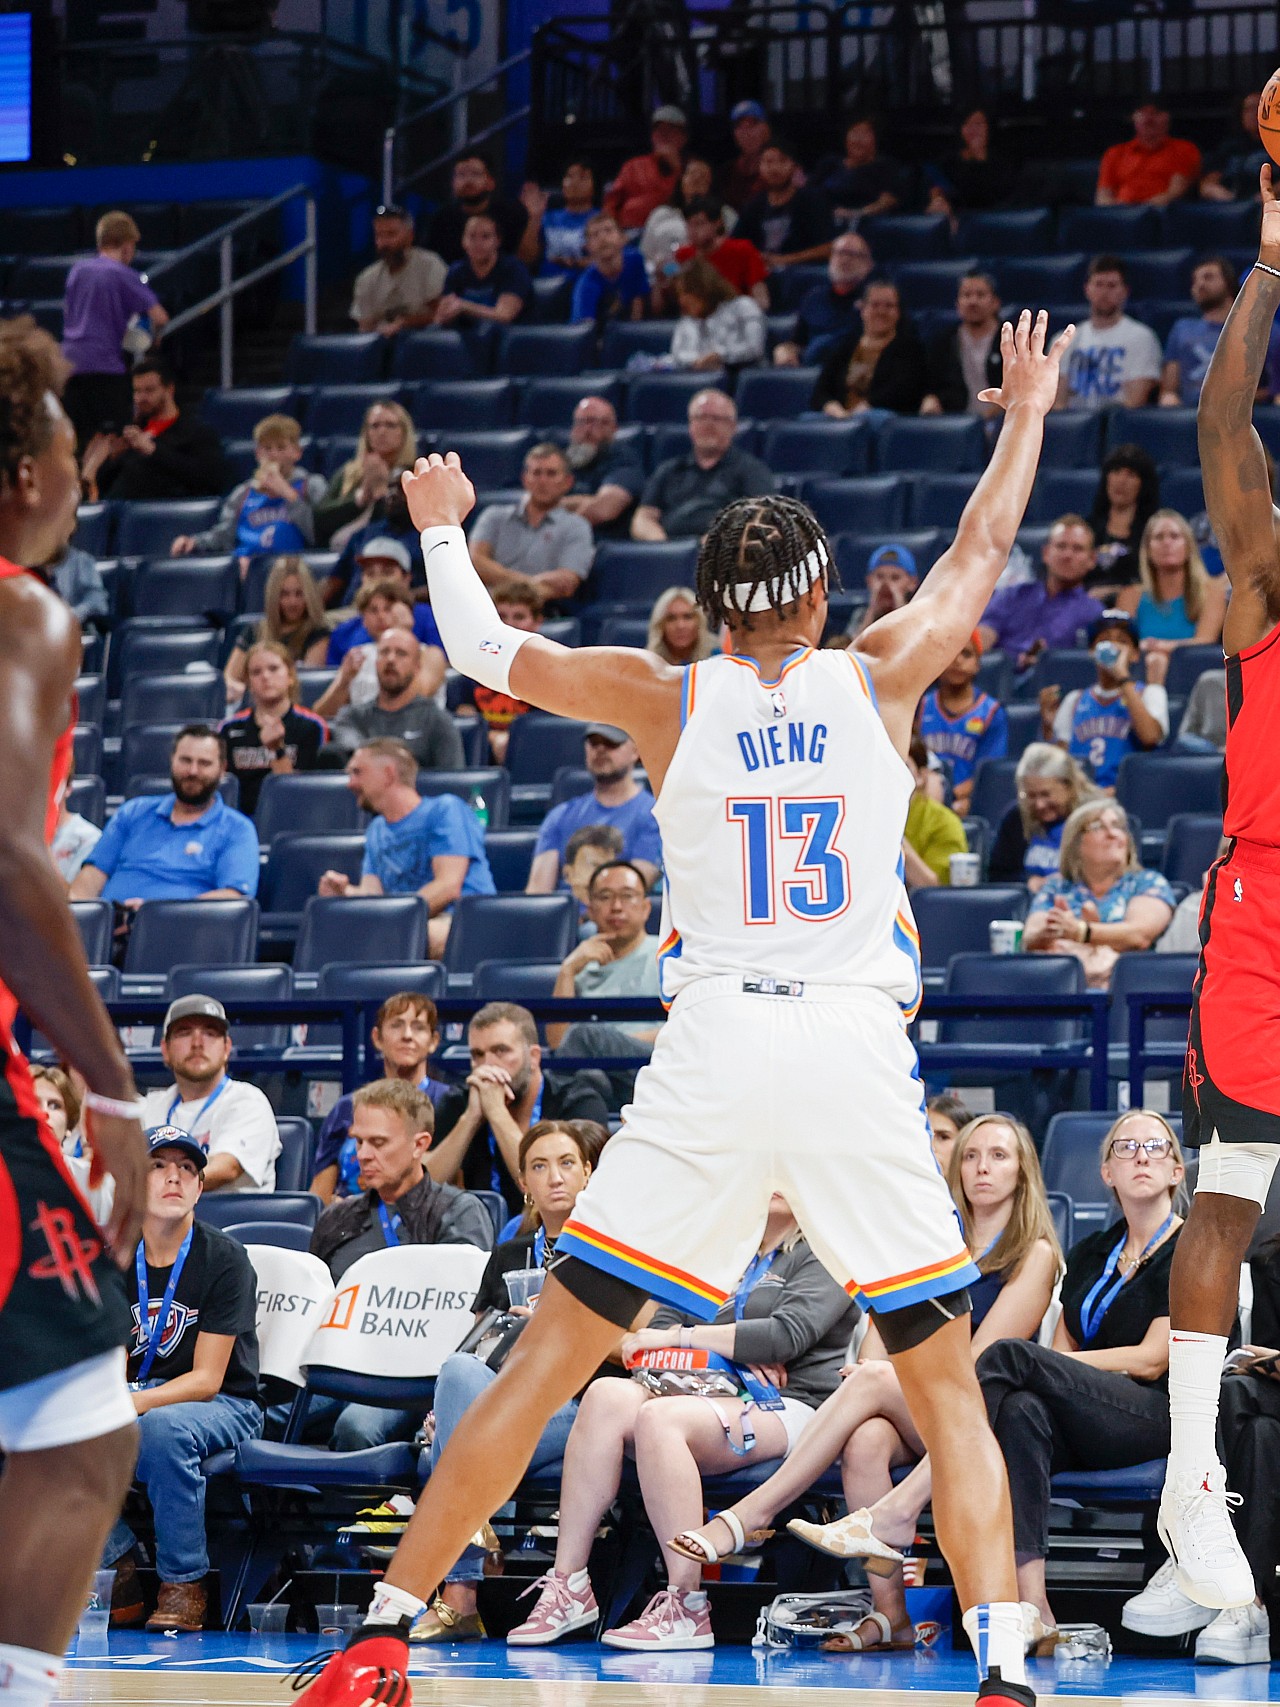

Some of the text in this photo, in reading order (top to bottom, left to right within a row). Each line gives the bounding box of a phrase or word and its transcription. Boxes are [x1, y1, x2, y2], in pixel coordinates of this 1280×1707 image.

[737, 722, 827, 772] DIENG
[1089, 737, 1107, 767] 2
[726, 795, 852, 926] 13
[641, 1350, 694, 1370] POPCORN
